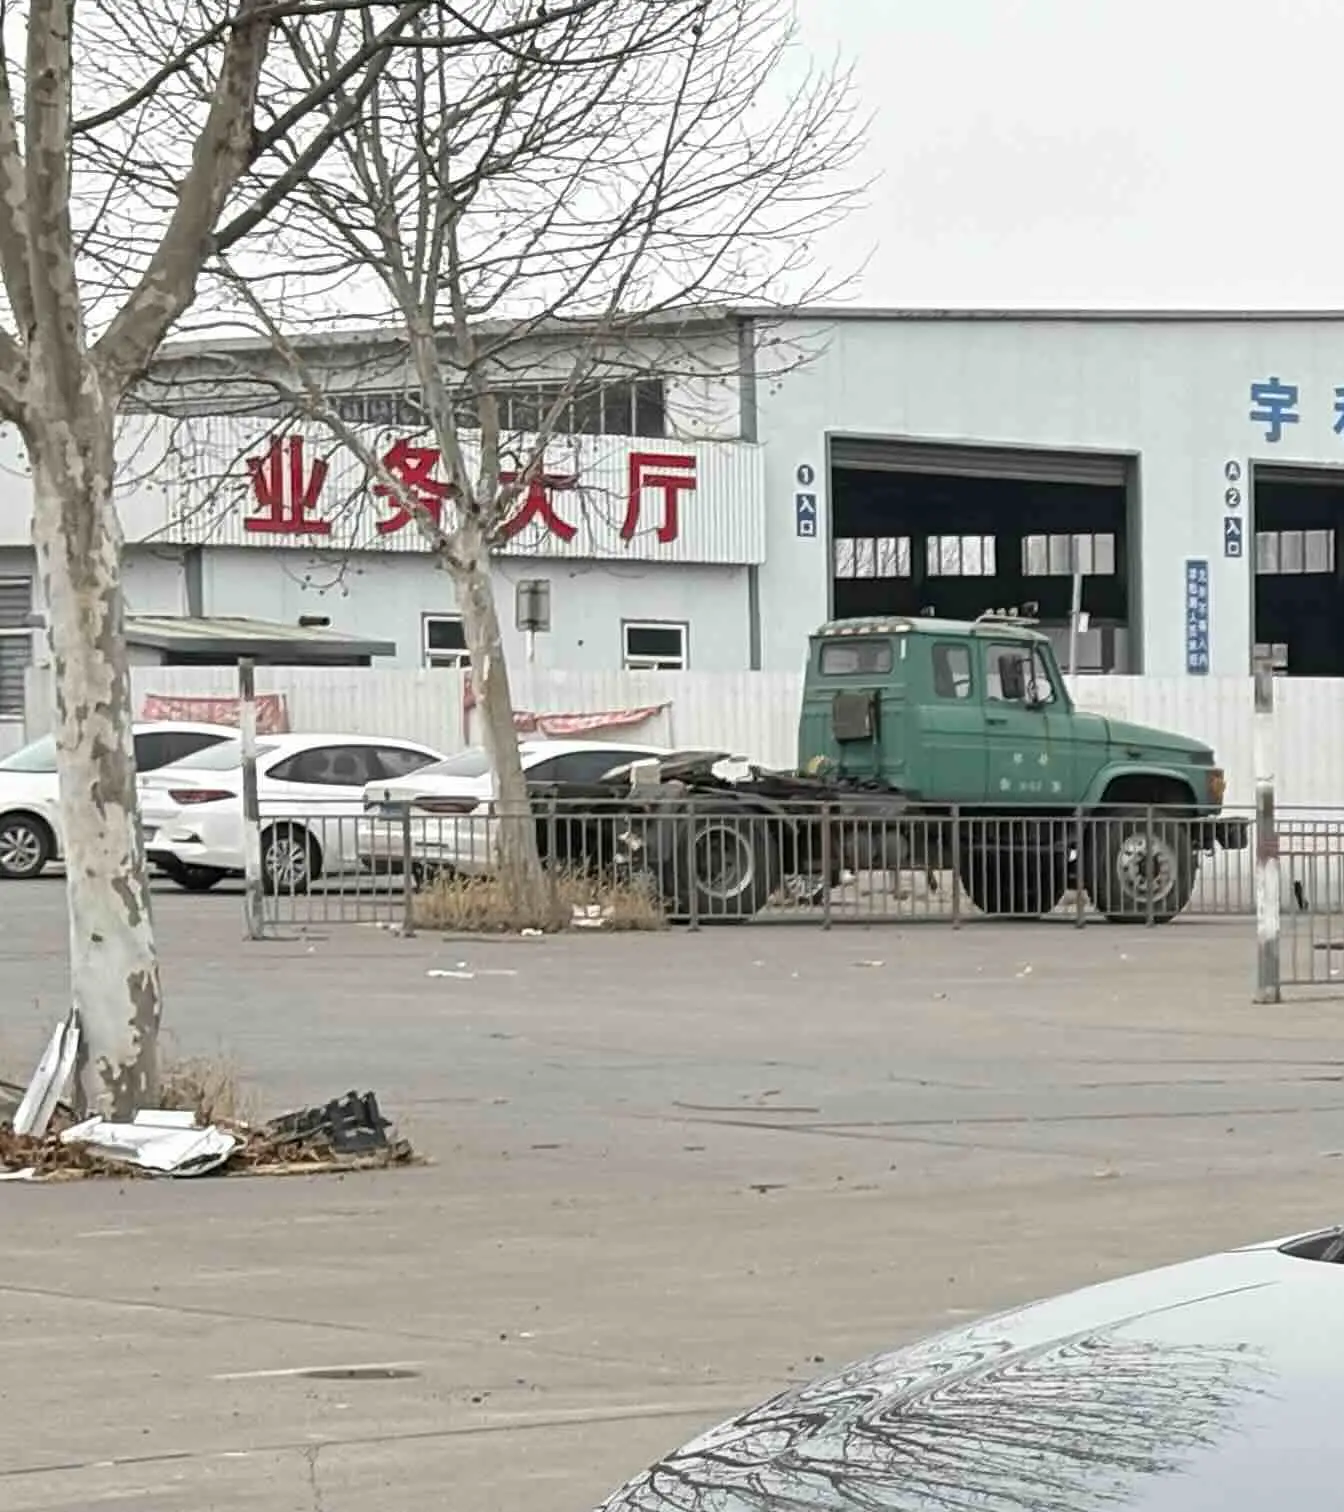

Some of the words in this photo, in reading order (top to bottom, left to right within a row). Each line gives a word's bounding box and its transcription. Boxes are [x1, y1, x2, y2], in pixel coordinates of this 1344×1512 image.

[243, 433, 697, 547] 业务大厅
[799, 495, 816, 535] 入口
[1226, 519, 1241, 555] 入口
